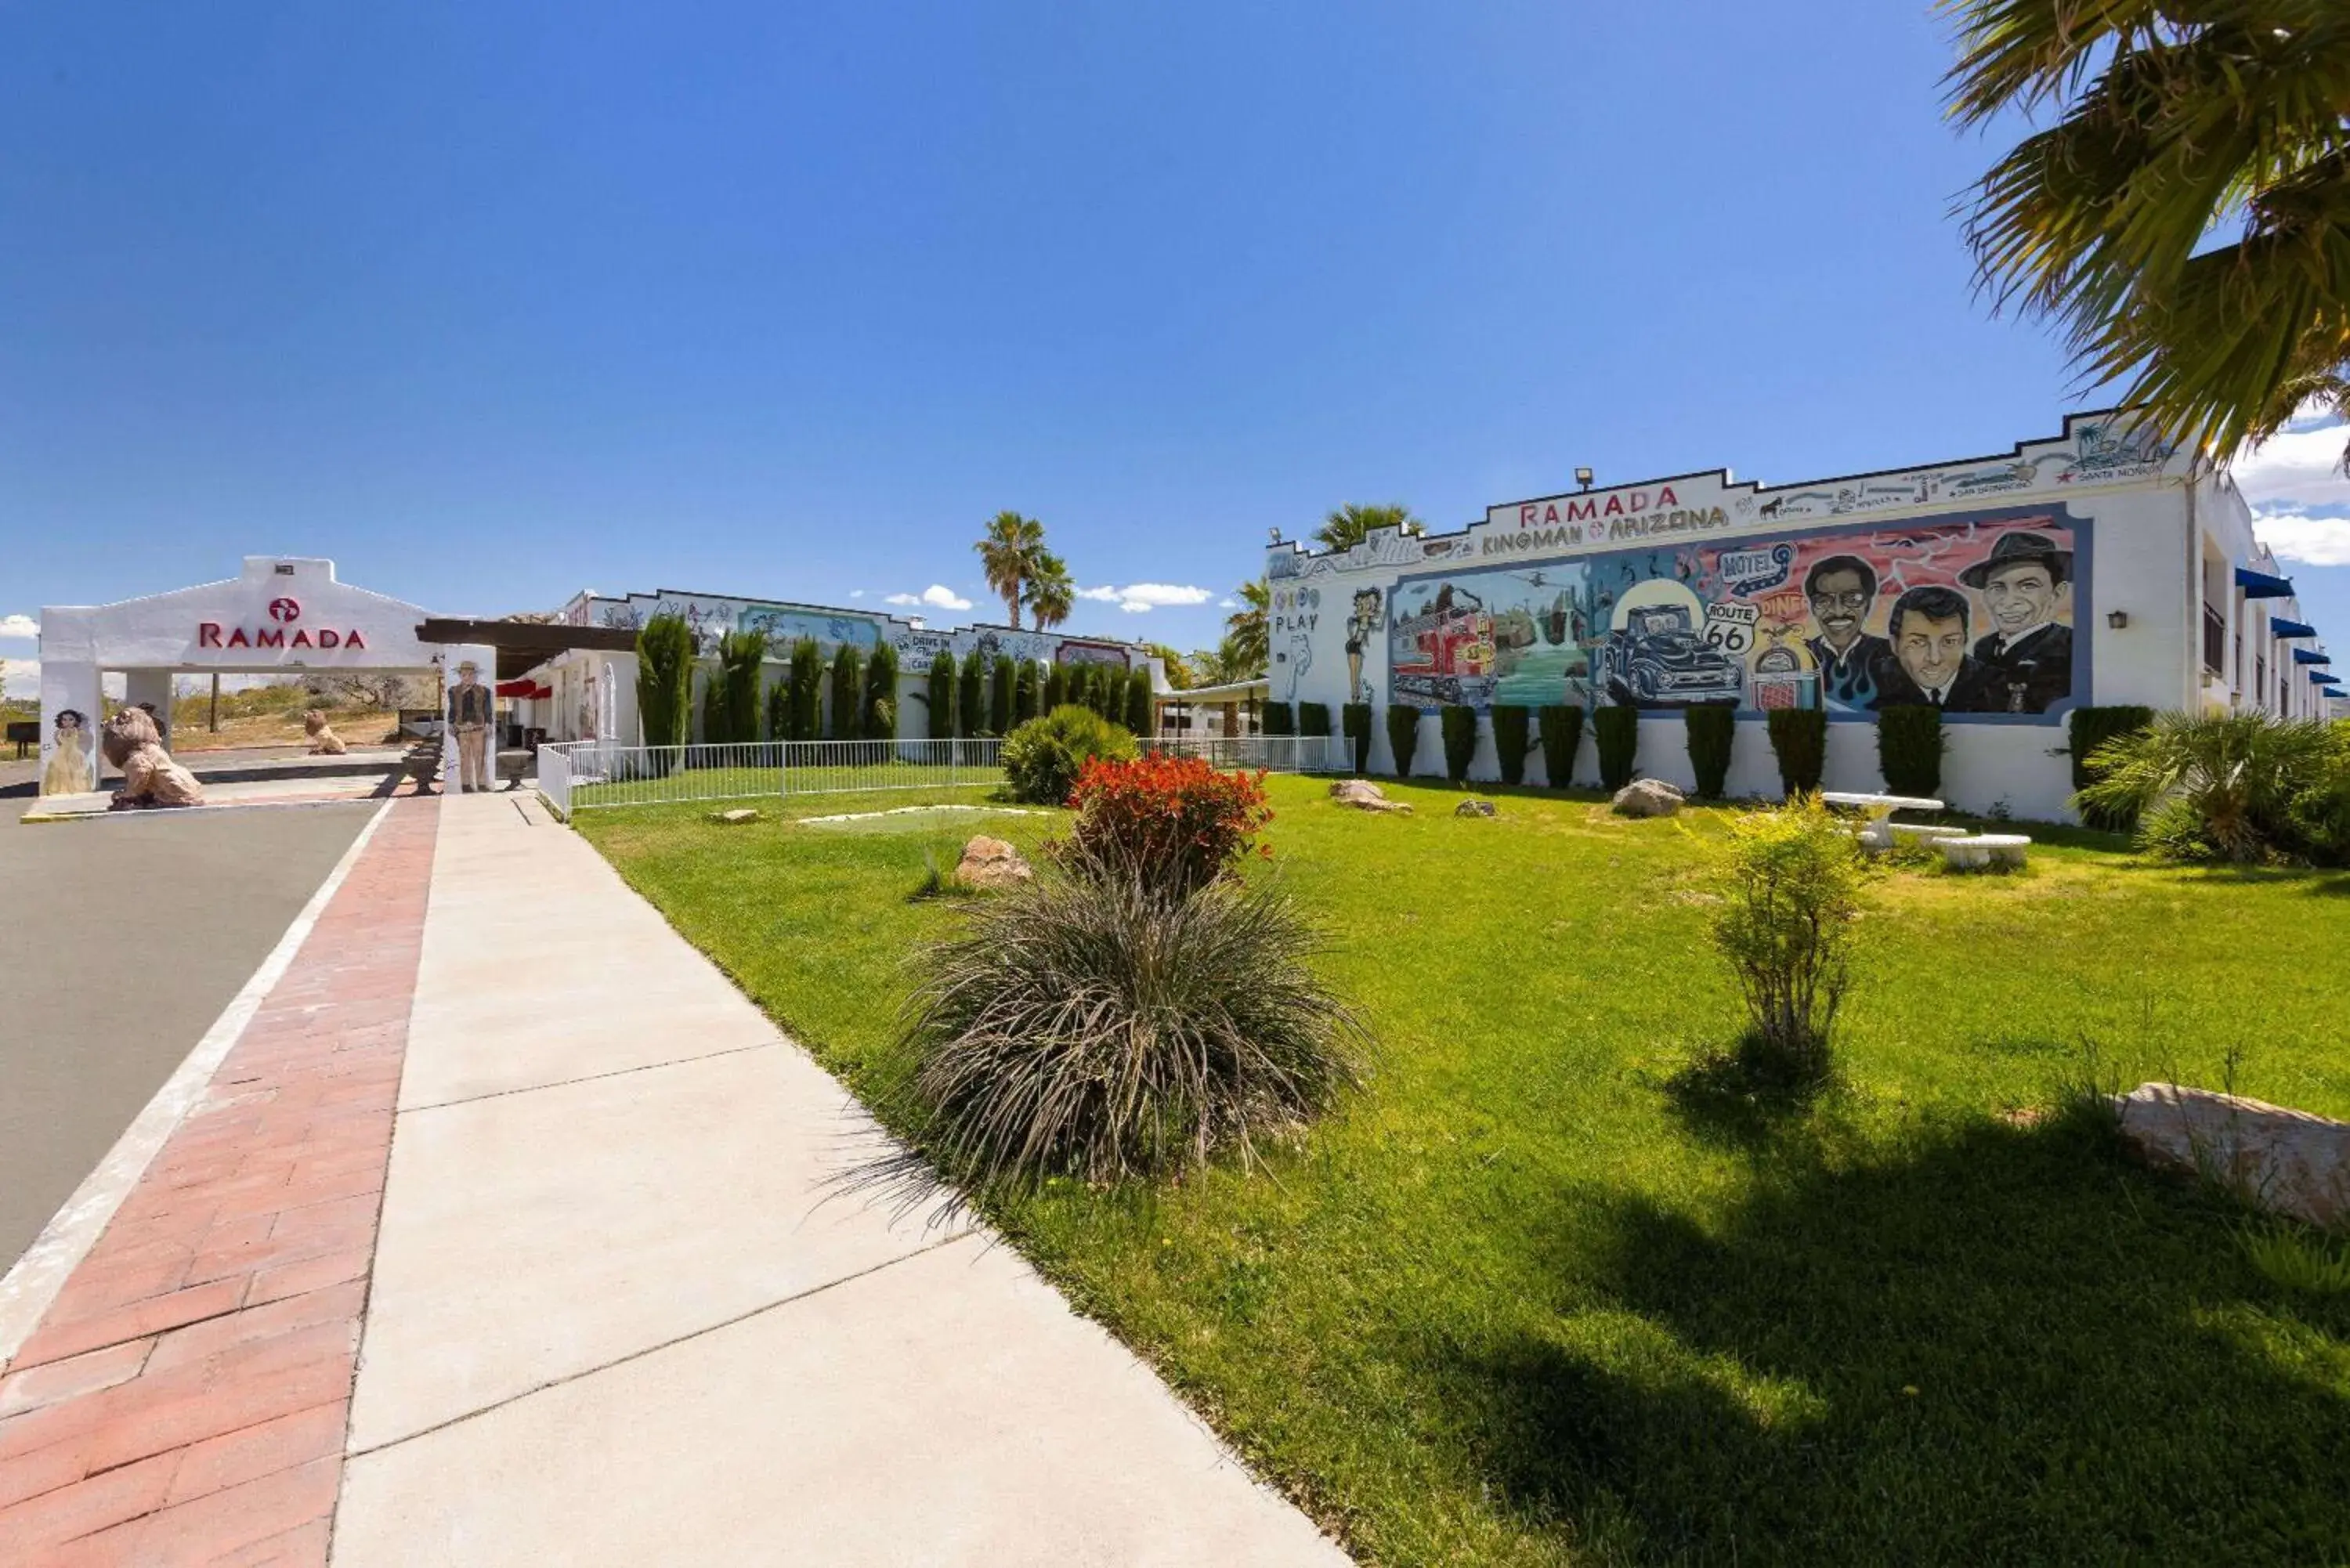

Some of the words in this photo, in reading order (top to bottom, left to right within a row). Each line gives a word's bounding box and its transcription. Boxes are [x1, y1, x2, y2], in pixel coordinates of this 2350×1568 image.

[2078, 470, 2113, 482] SANTA
[1520, 486, 1679, 529] RAMADA
[1482, 526, 1583, 555] KINGMAN
[1610, 506, 1726, 540] ARIZONA
[1723, 555, 1770, 577] MOTEL
[1276, 614, 1318, 634] PLAY
[1708, 606, 1753, 620] ROUTE
[200, 623, 364, 649] RAMADA
[913, 635, 938, 647] DRIVE
[940, 638, 950, 649] IN
[1707, 624, 1744, 651] 66
